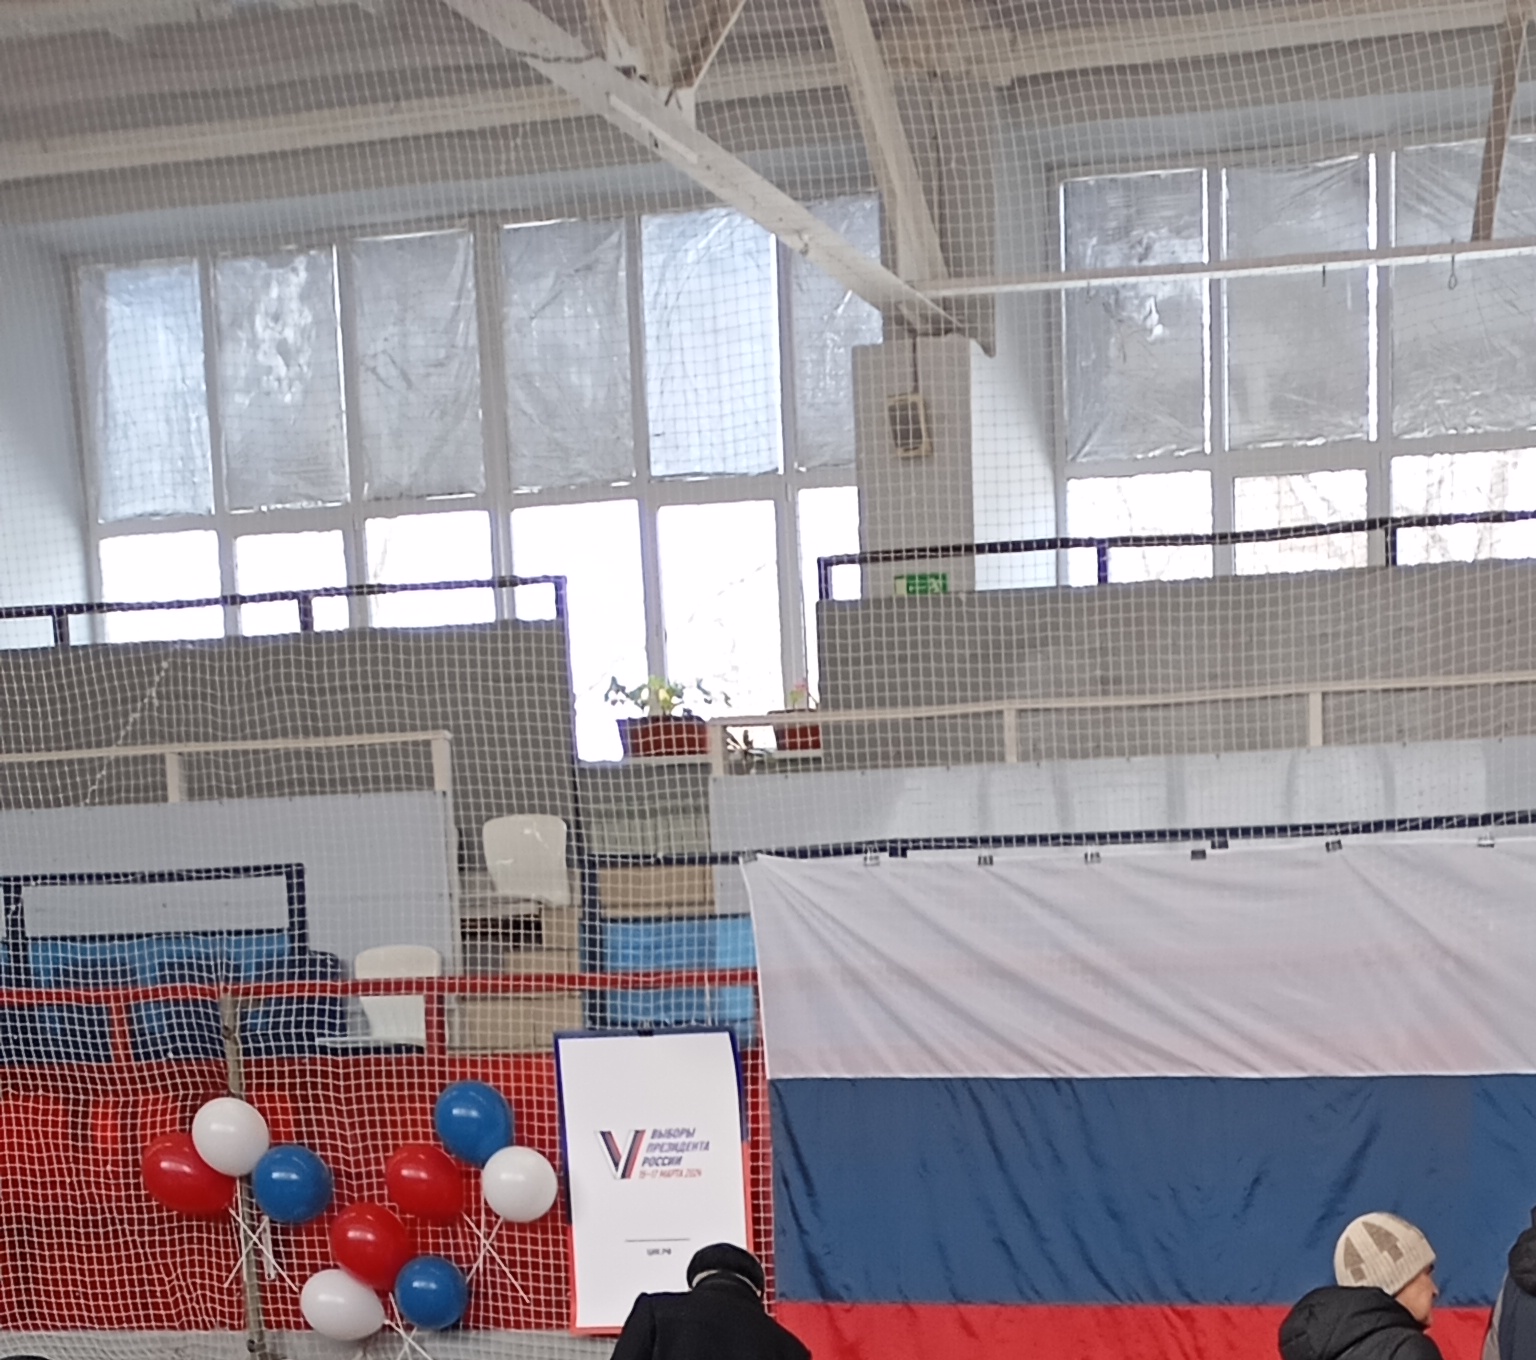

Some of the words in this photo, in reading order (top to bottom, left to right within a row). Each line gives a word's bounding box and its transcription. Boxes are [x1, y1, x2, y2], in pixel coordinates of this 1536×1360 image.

[650, 1128, 696, 1139] ВЫБОРЫ
[646, 1141, 710, 1153] ПРЕЗИДЕНТА
[641, 1156, 683, 1167] РОССИИ
